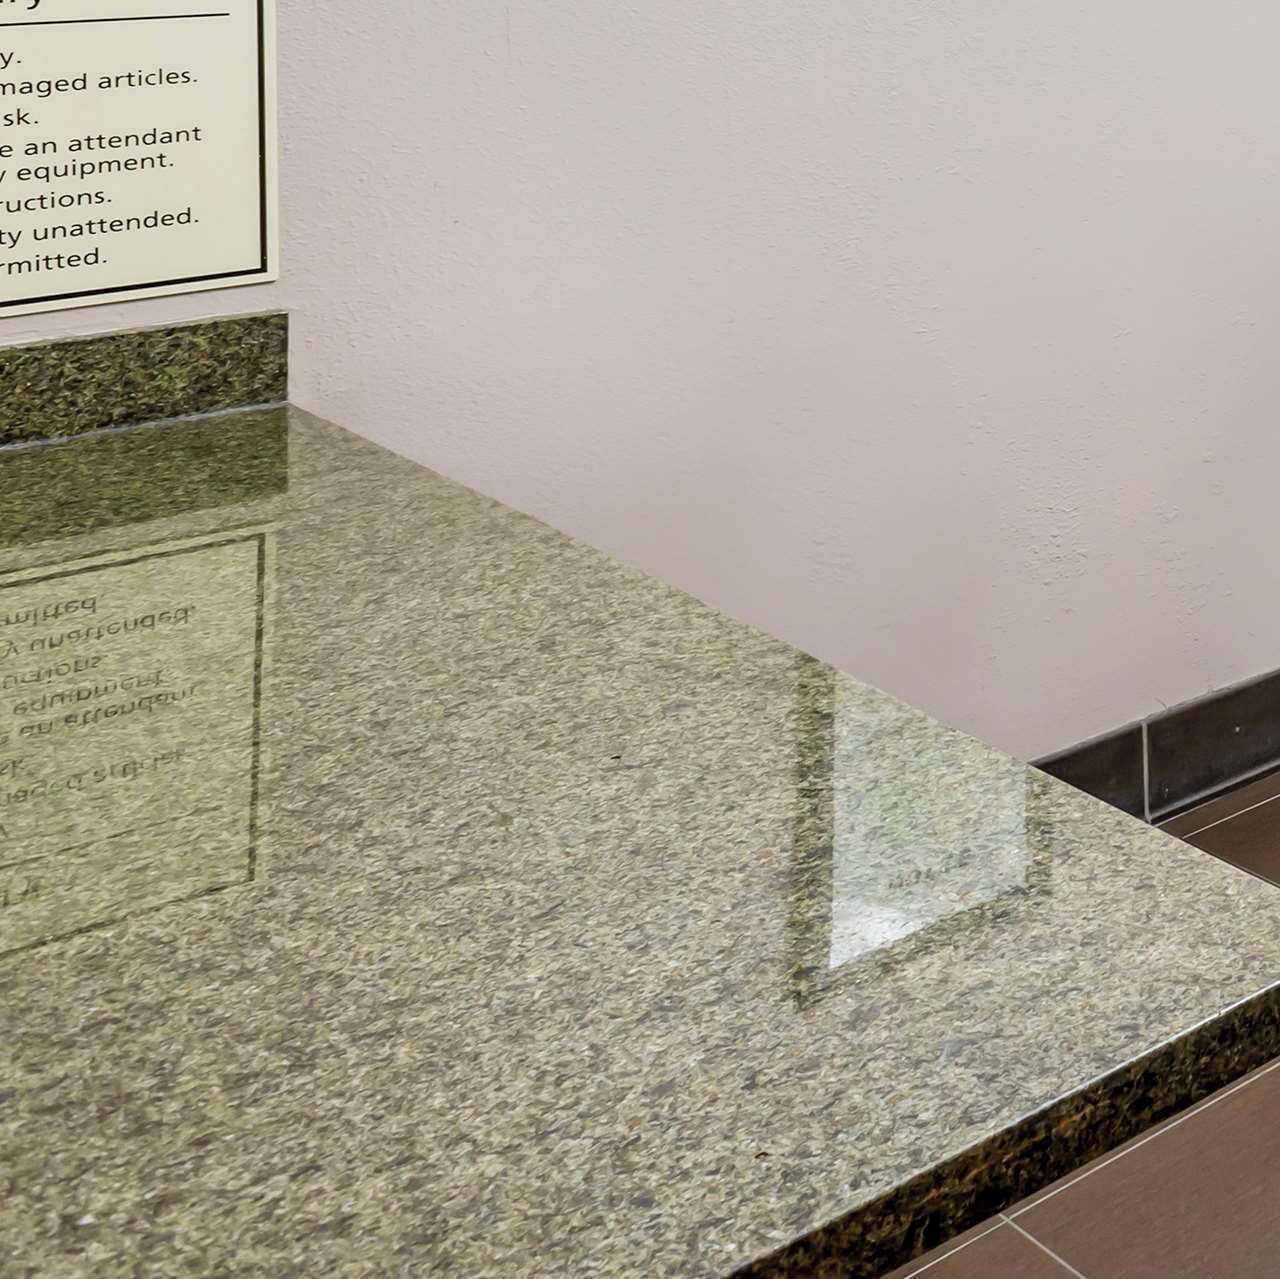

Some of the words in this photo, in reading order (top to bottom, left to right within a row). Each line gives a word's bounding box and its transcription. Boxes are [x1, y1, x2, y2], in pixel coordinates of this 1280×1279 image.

[98, 68, 198, 89] articles.
[3, 108, 39, 127] sk.
[24, 141, 57, 155] an
[68, 126, 201, 151] attendant
[17, 153, 174, 183] equipment.
[33, 207, 199, 241] unattended.
